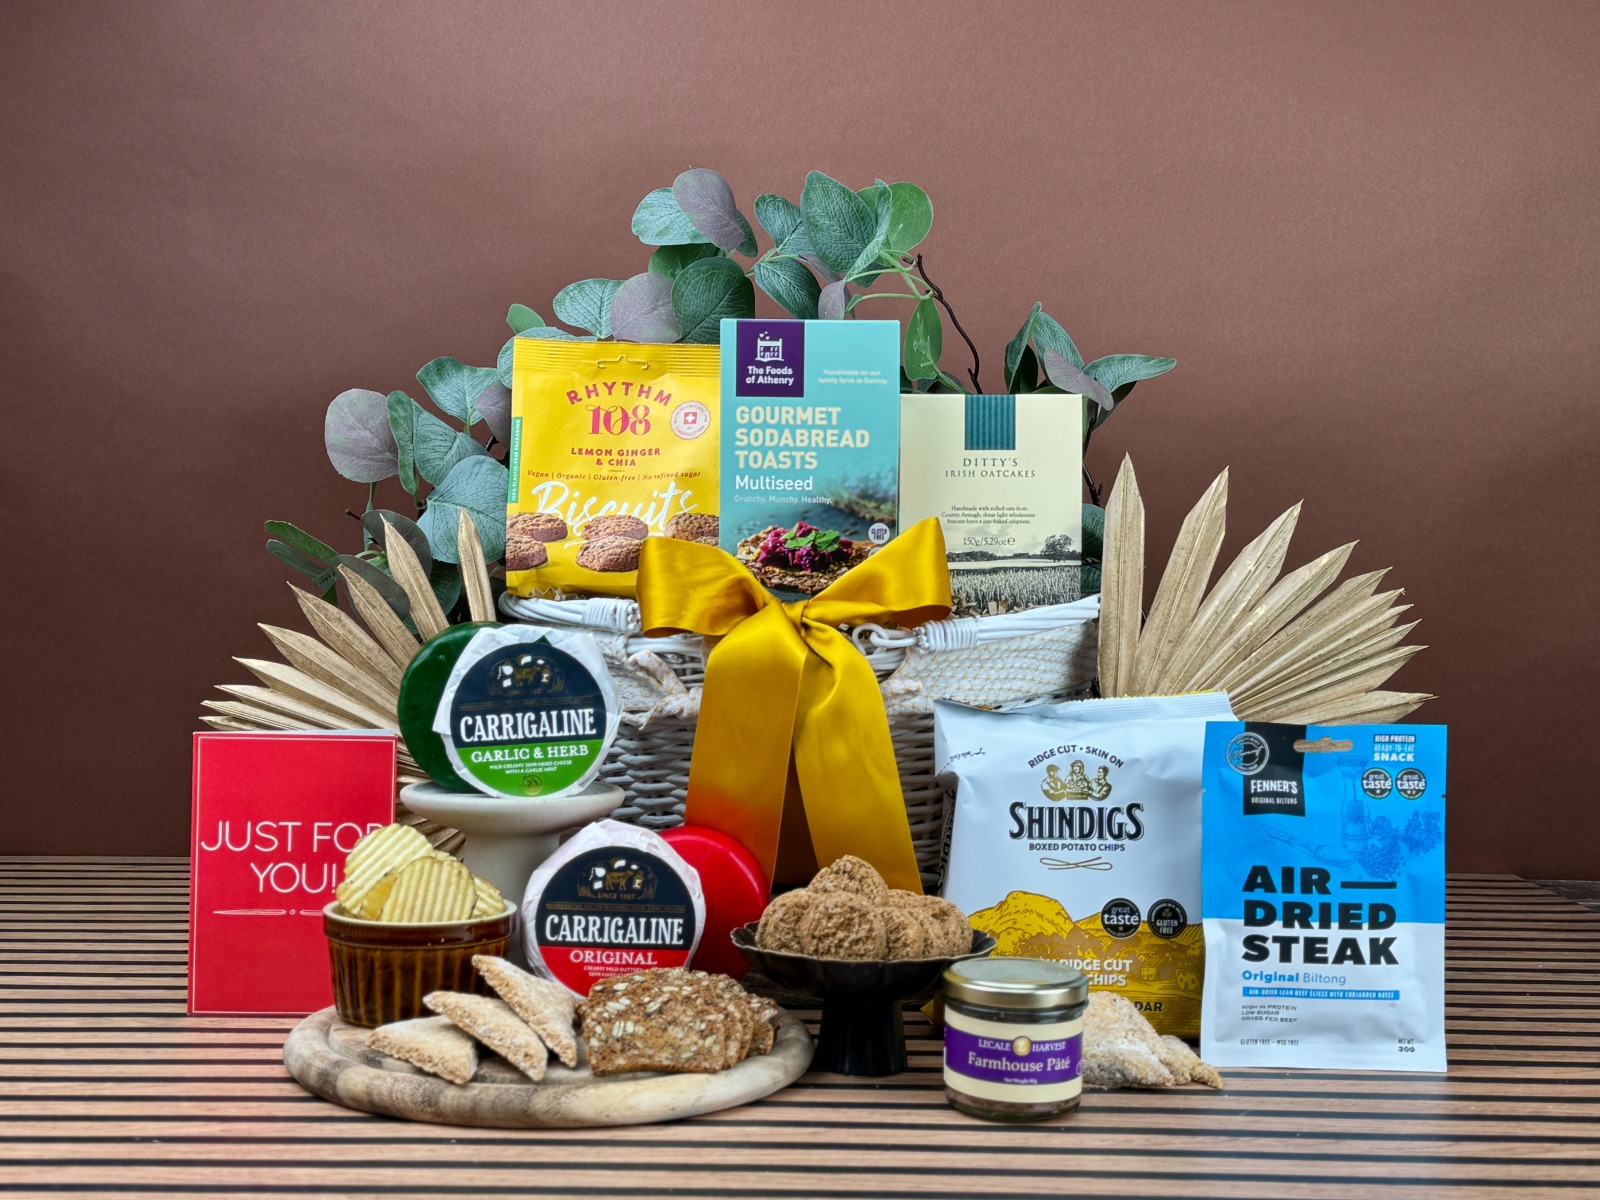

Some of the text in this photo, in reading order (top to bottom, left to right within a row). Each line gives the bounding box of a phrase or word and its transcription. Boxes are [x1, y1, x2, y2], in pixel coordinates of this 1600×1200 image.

[747, 365, 793, 375] The Foods
[745, 375, 795, 386] of Athenry
[565, 381, 673, 407] RHYTHM
[585, 403, 652, 436] 108
[735, 405, 841, 425] GOURMET
[735, 428, 870, 448] SODABREAD
[571, 447, 661, 457] LEMON GINGER
[595, 458, 637, 467] & CHIA
[735, 450, 818, 470] TOASTS
[963, 457, 1018, 467] DITTY'S
[527, 470, 549, 479] Vegan
[556, 473, 587, 481] Organic
[593, 474, 636, 482] Gluten-free
[653, 472, 679, 482] refined
[680, 471, 702, 480] sugar
[945, 470, 1036, 478] IRISH OATCAKES
[735, 475, 813, 491] Multiseed
[734, 494, 833, 505] Crunchy. Munchy. Healthy.
[532, 480, 698, 536] Biscuits
[460, 708, 597, 743] CARRIGALINE
[1374, 735, 1415, 743] HIGH PROTEIN
[471, 745, 589, 763] GARLIC & HERB
[1374, 744, 1415, 752] READY-TO-EAT
[1027, 744, 1125, 769] RIDGE CUT SKIN ON
[1373, 752, 1415, 762] SNACK
[1250, 780, 1298, 795] FENNER'S
[1362, 779, 1392, 789] taste
[1396, 780, 1426, 790] taste
[1009, 801, 1145, 841] SHINDIGS
[200, 820, 302, 853] JUST
[1029, 843, 1126, 852] BOXED POTATO CHIPS
[250, 862, 337, 894] YOU!
[1111, 906, 1130, 915] great
[1243, 899, 1397, 931] DRIED
[1103, 912, 1139, 925] taste
[1156, 919, 1178, 927] GLUTEN
[545, 914, 684, 945] CARRIGALINE
[1159, 926, 1174, 934] FREE
[1241, 934, 1400, 966] STEAK
[570, 949, 658, 965] ORIGINAL
[1103, 959, 1133, 972] CUT
[1087, 974, 1127, 987] CHIPS
[1241, 970, 1347, 986] Original Biltong
[978, 1039, 1012, 1051] LECALE
[1032, 1041, 1067, 1052] HARVEST
[967, 1051, 1071, 1072] Farmhouse Pâté
